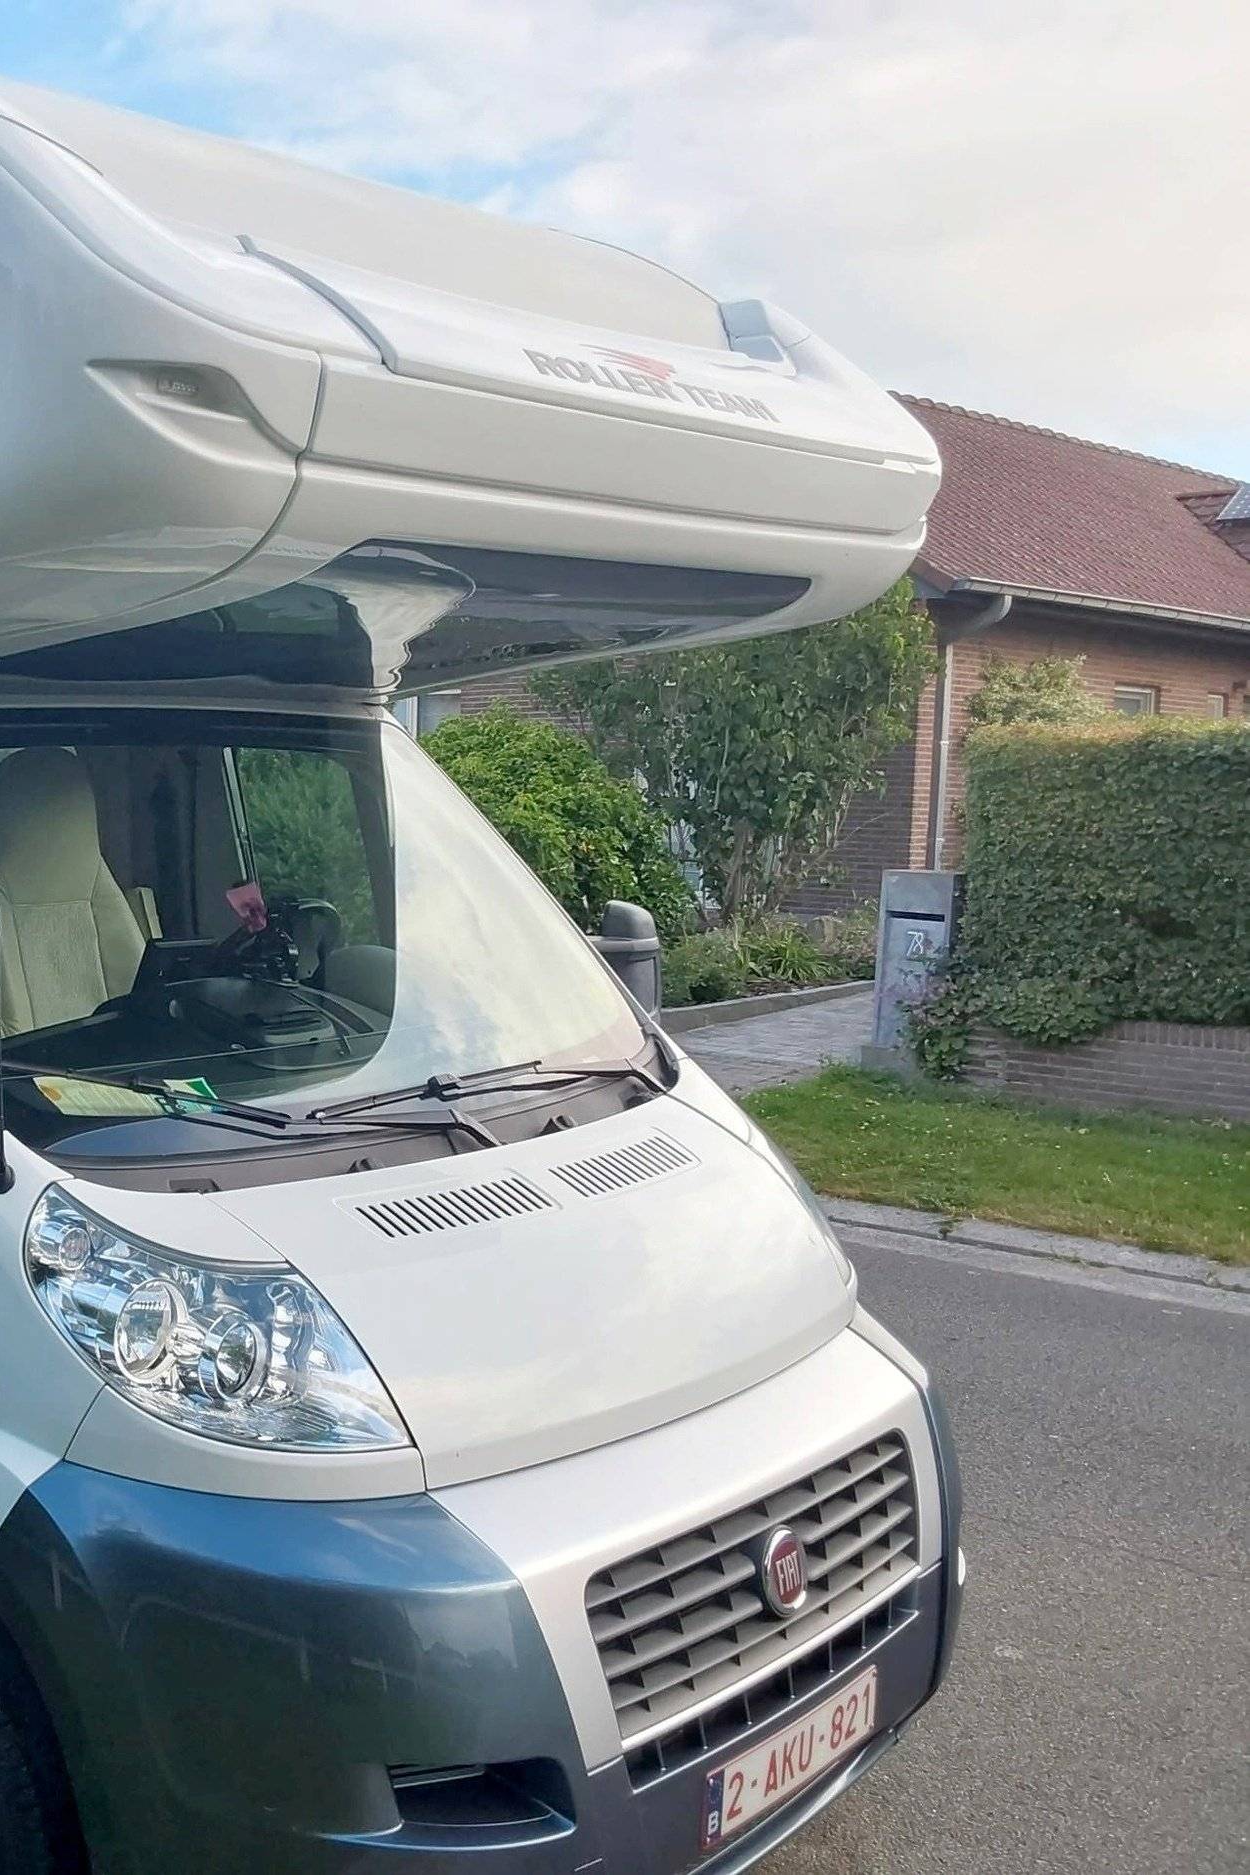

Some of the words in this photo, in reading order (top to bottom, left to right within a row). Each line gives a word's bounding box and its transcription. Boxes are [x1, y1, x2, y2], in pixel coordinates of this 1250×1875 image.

[523, 348, 684, 402] ROLLER
[674, 381, 781, 423] TEAM
[775, 1550, 800, 1596] FIAT
[726, 1684, 871, 1821] 2-AKU-821
[707, 1810, 719, 1836] B
